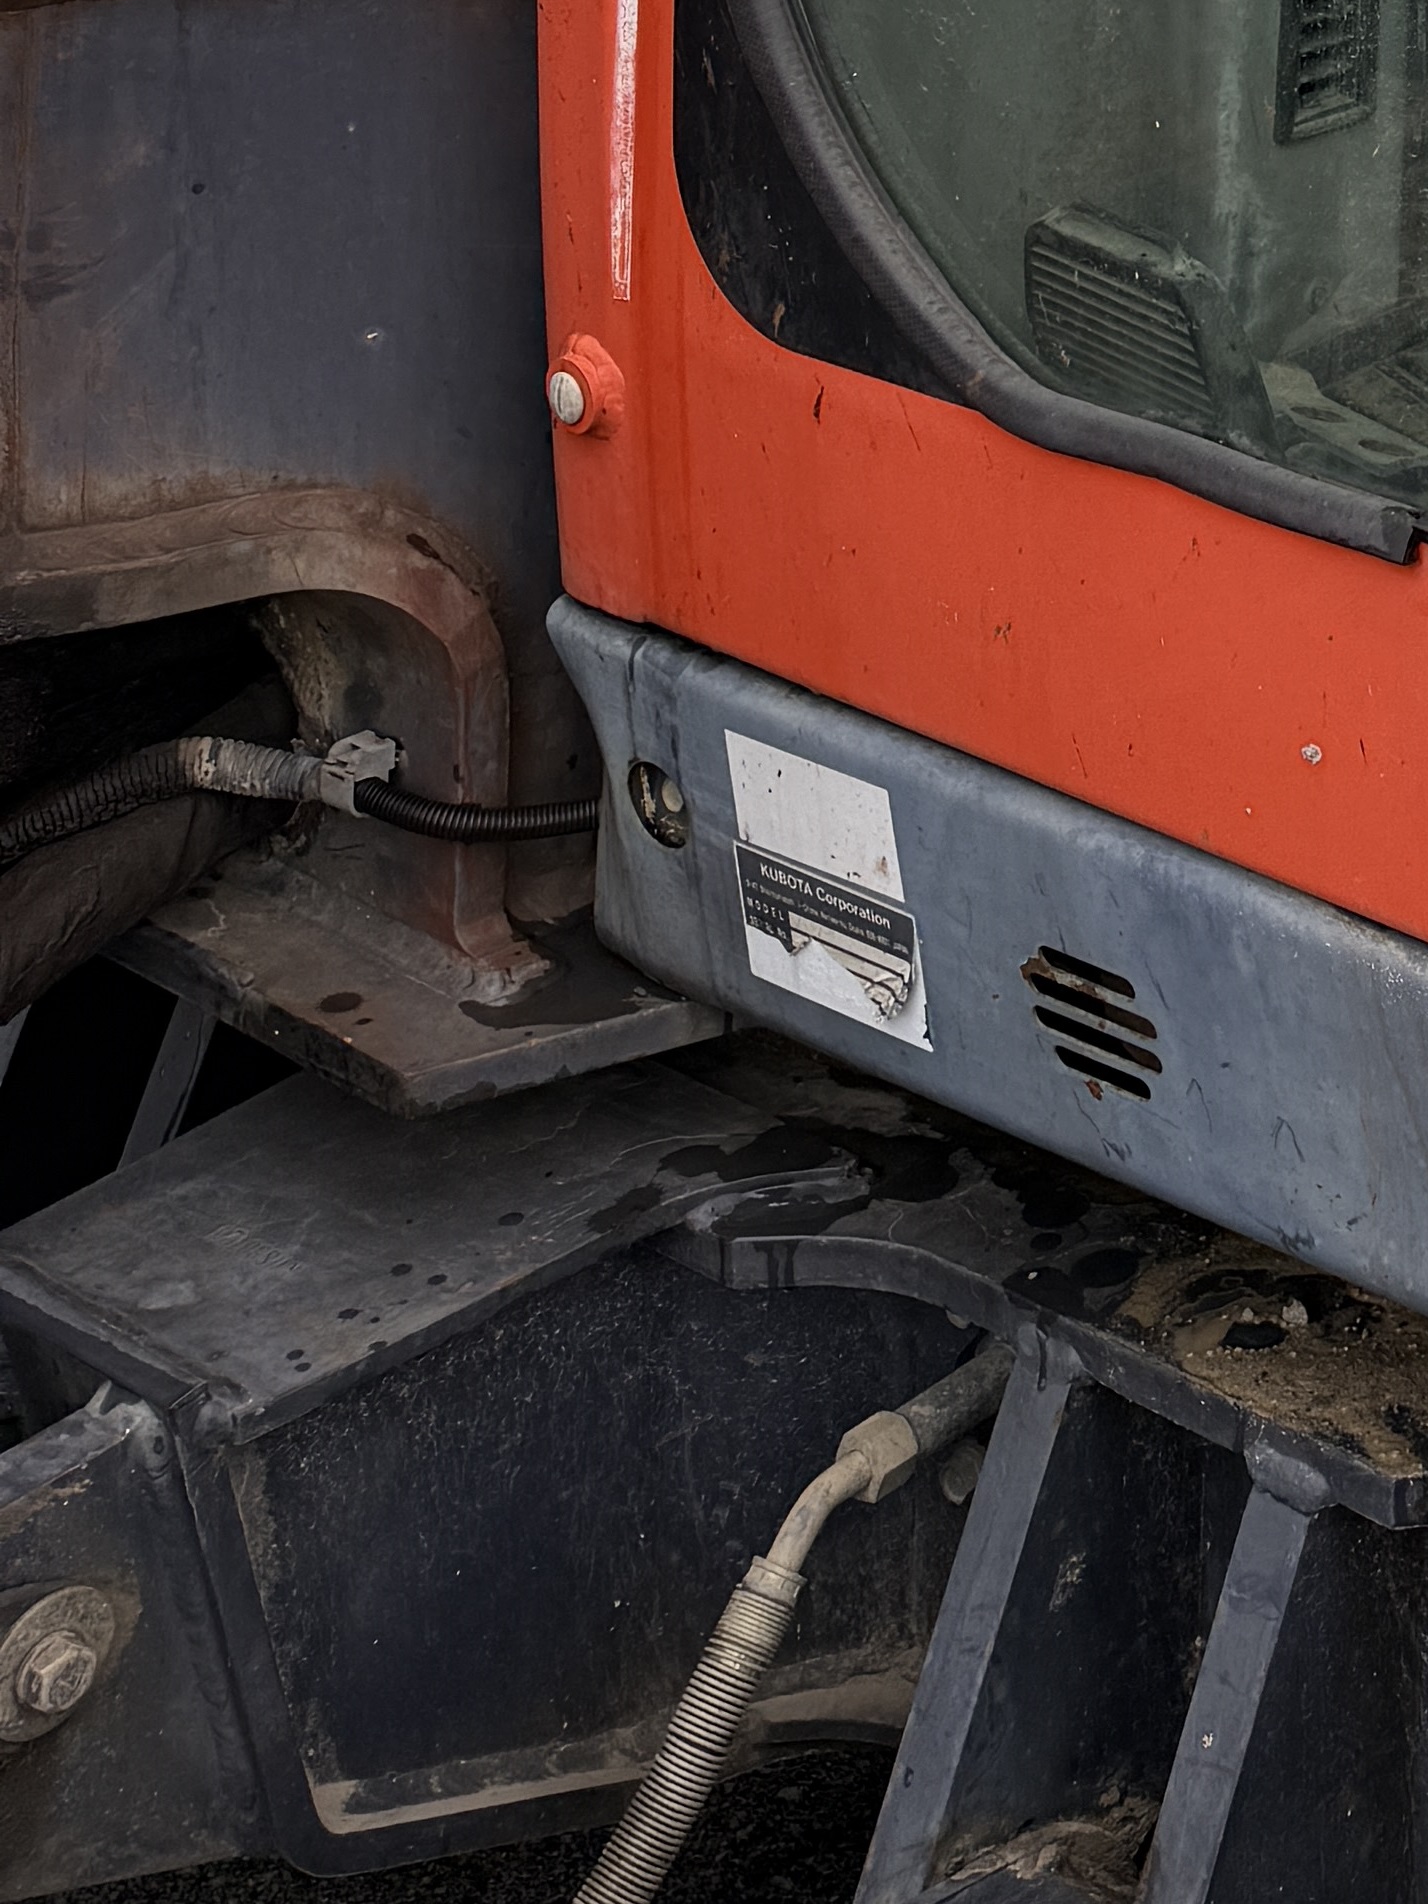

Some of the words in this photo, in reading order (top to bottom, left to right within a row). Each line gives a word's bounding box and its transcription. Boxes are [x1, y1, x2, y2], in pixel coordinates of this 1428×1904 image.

[746, 896, 785, 922] MODEL
[759, 862, 814, 897] KUBOTA
[815, 886, 892, 930] Corporation
